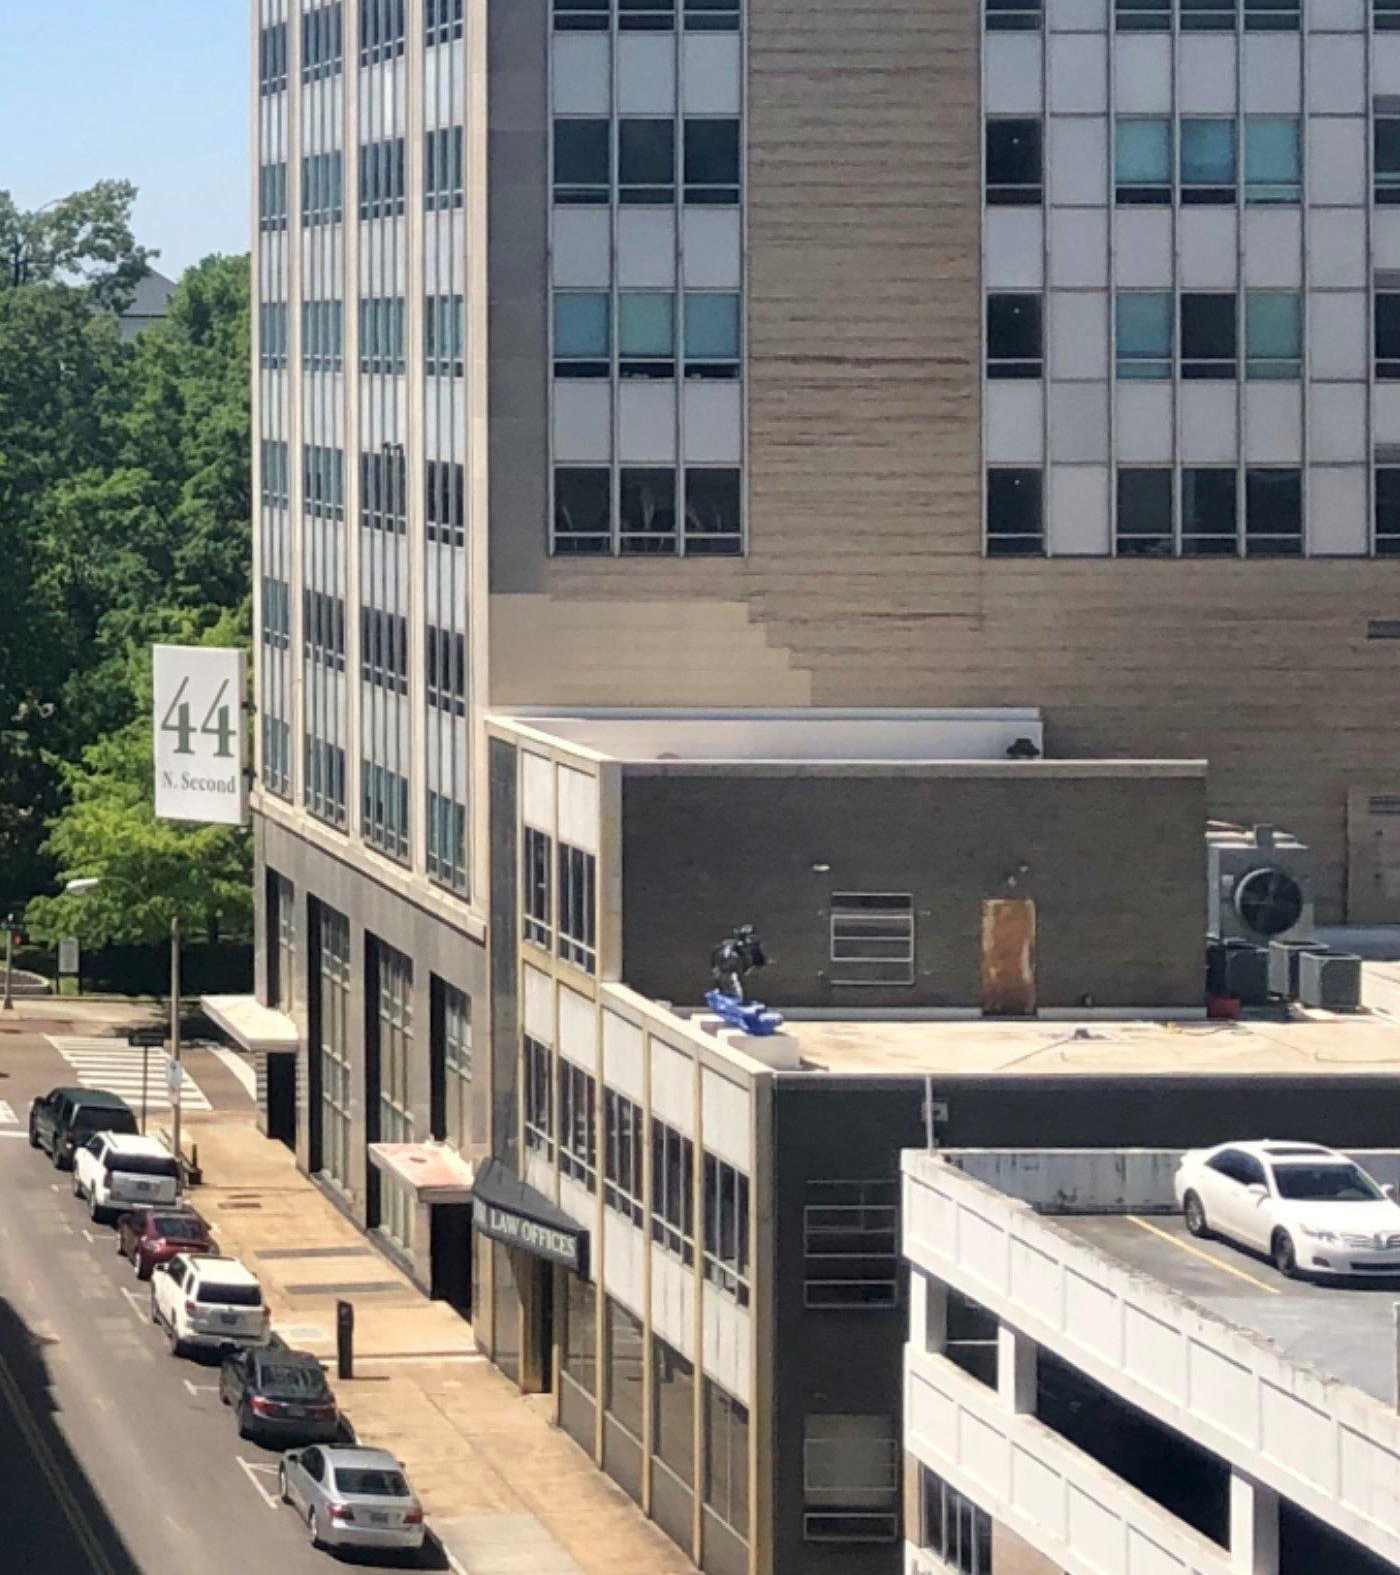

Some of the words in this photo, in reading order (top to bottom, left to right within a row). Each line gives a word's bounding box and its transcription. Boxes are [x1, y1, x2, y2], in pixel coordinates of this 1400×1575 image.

[161, 676, 237, 758] 44
[162, 770, 178, 789] N.
[181, 771, 236, 794] Second
[491, 1209, 520, 1235] LAW
[521, 1219, 576, 1257] OFFICES
